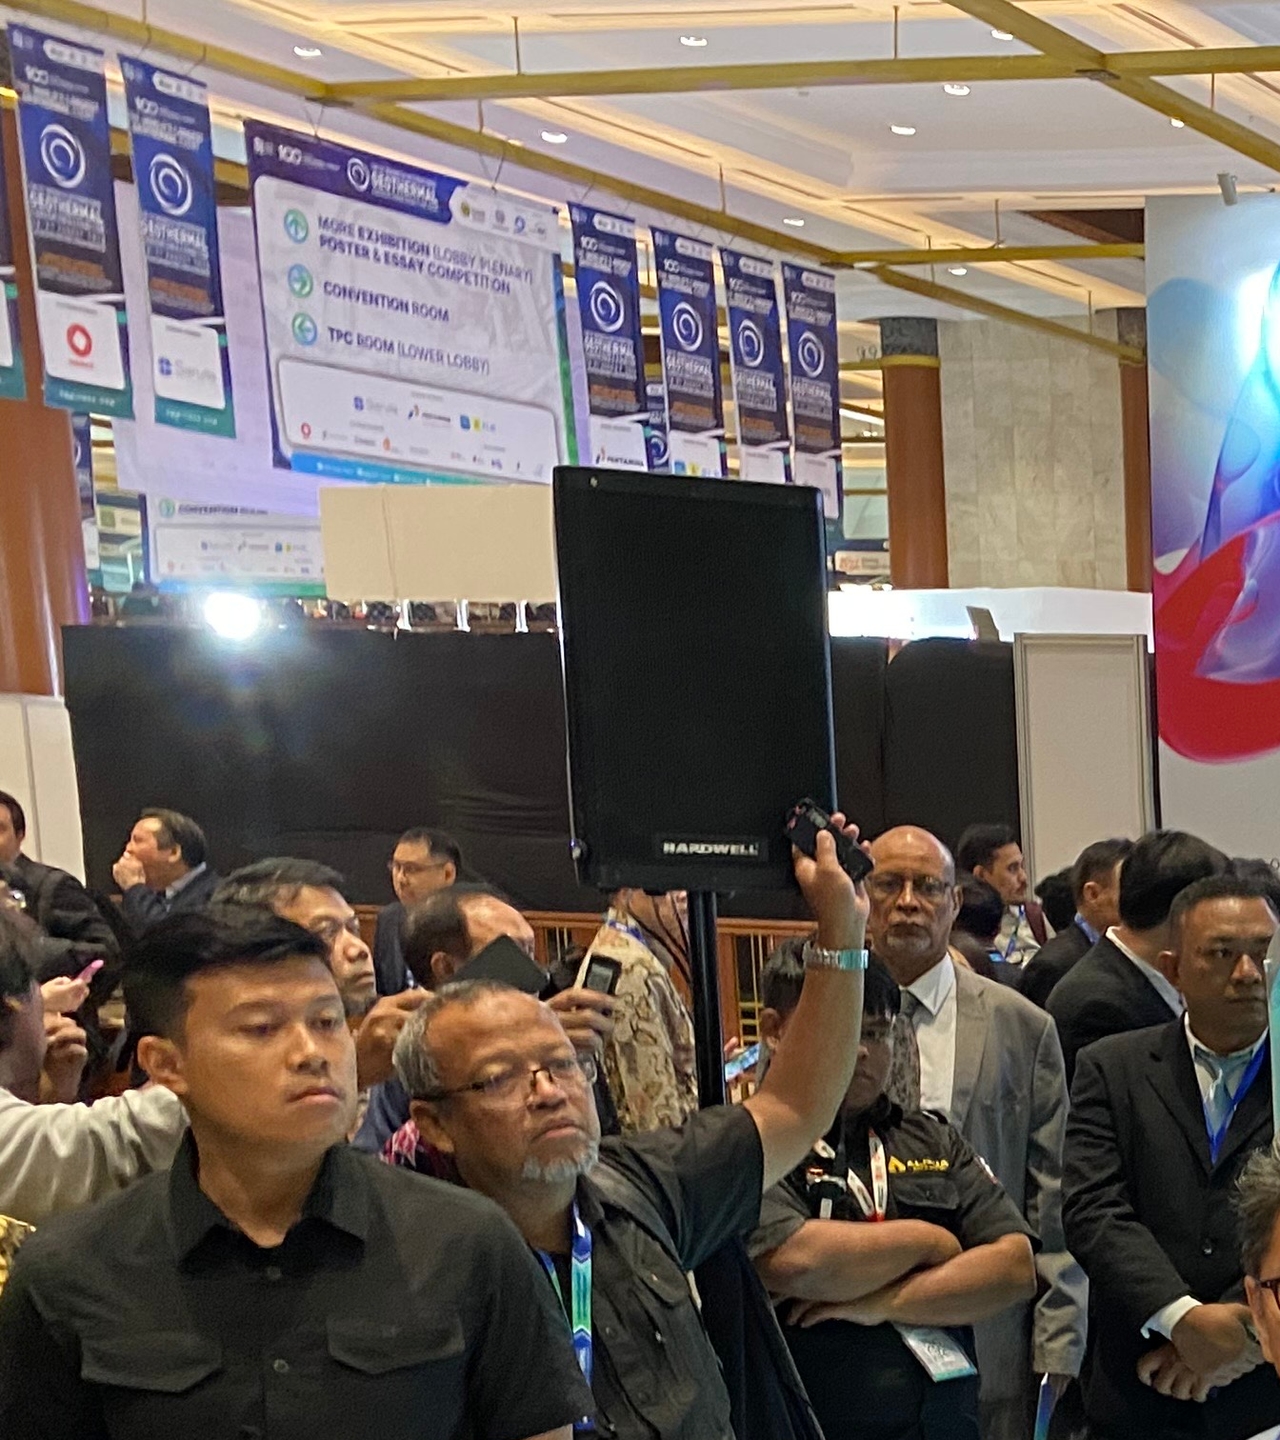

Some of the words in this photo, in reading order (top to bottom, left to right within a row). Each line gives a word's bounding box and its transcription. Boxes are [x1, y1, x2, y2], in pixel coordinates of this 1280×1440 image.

[318, 214, 356, 237] MORE
[358, 225, 431, 256] EXHIBITION
[319, 234, 370, 260] POSTER
[372, 248, 382, 263] &
[383, 250, 425, 277] ESSAY
[427, 261, 511, 295] COMPETITION
[323, 281, 409, 313] CONVENTION
[412, 302, 449, 322] ROOM
[328, 326, 354, 346] TPC
[357, 332, 395, 355] ROOM
[397, 340, 445, 366] (LOWER
[447, 353, 490, 376] LOBBY)
[663, 842, 759, 856] HARDWELL
